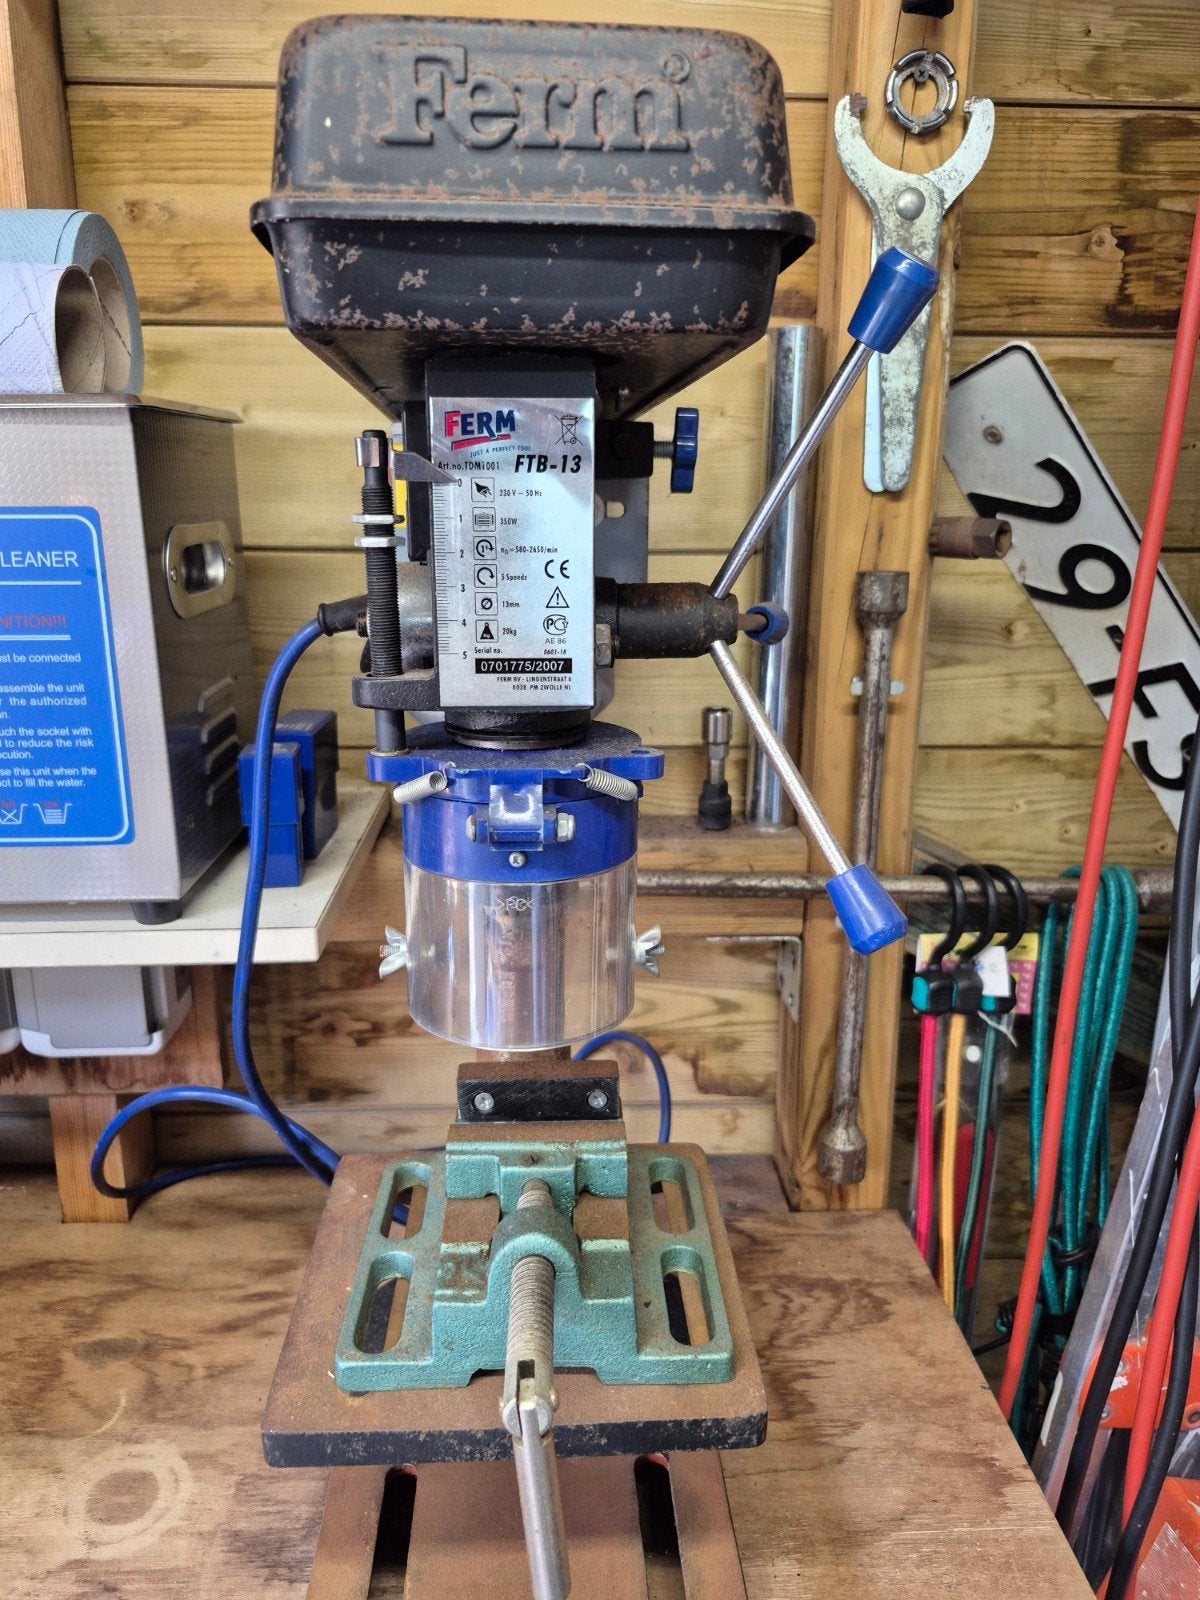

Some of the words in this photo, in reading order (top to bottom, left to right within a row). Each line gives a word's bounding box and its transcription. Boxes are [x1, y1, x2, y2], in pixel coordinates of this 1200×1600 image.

[445, 410, 516, 438] FERM
[470, 450, 484, 458] JUST
[515, 454, 582, 474] FTB-13
[457, 479, 463, 488] 0
[460, 550, 465, 558] 2
[0, 550, 80, 568] LEANER
[506, 574, 527, 582] Speeds
[461, 584, 466, 593] 3
[462, 618, 467, 627] 4
[502, 628, 517, 636] 20kg
[474, 646, 492, 654] Serial
[13, 652, 26, 662] be
[29, 652, 81, 662] connected
[463, 651, 468, 660] 5
[480, 661, 565, 672] 0701775/2007
[0, 683, 45, 692] assemble
[47, 683, 63, 692] the
[66, 683, 85, 692] unit
[9, 696, 26, 705] the
[30, 696, 87, 706] authorized
[19, 727, 34, 736] the
[37, 727, 69, 736] socket
[72, 727, 92, 736] with
[5, 739, 14, 747] to
[18, 738, 53, 748] reduce
[55, 738, 72, 747] the
[75, 738, 94, 747] risk
[14, 766, 30, 776] this
[33, 766, 51, 776] unit
[53, 766, 79, 776] when
[81, 766, 97, 776] the
[14, 778, 23, 787] to
[25, 778, 36, 787] fill
[38, 778, 54, 787] the
[56, 778, 86, 787] water.
